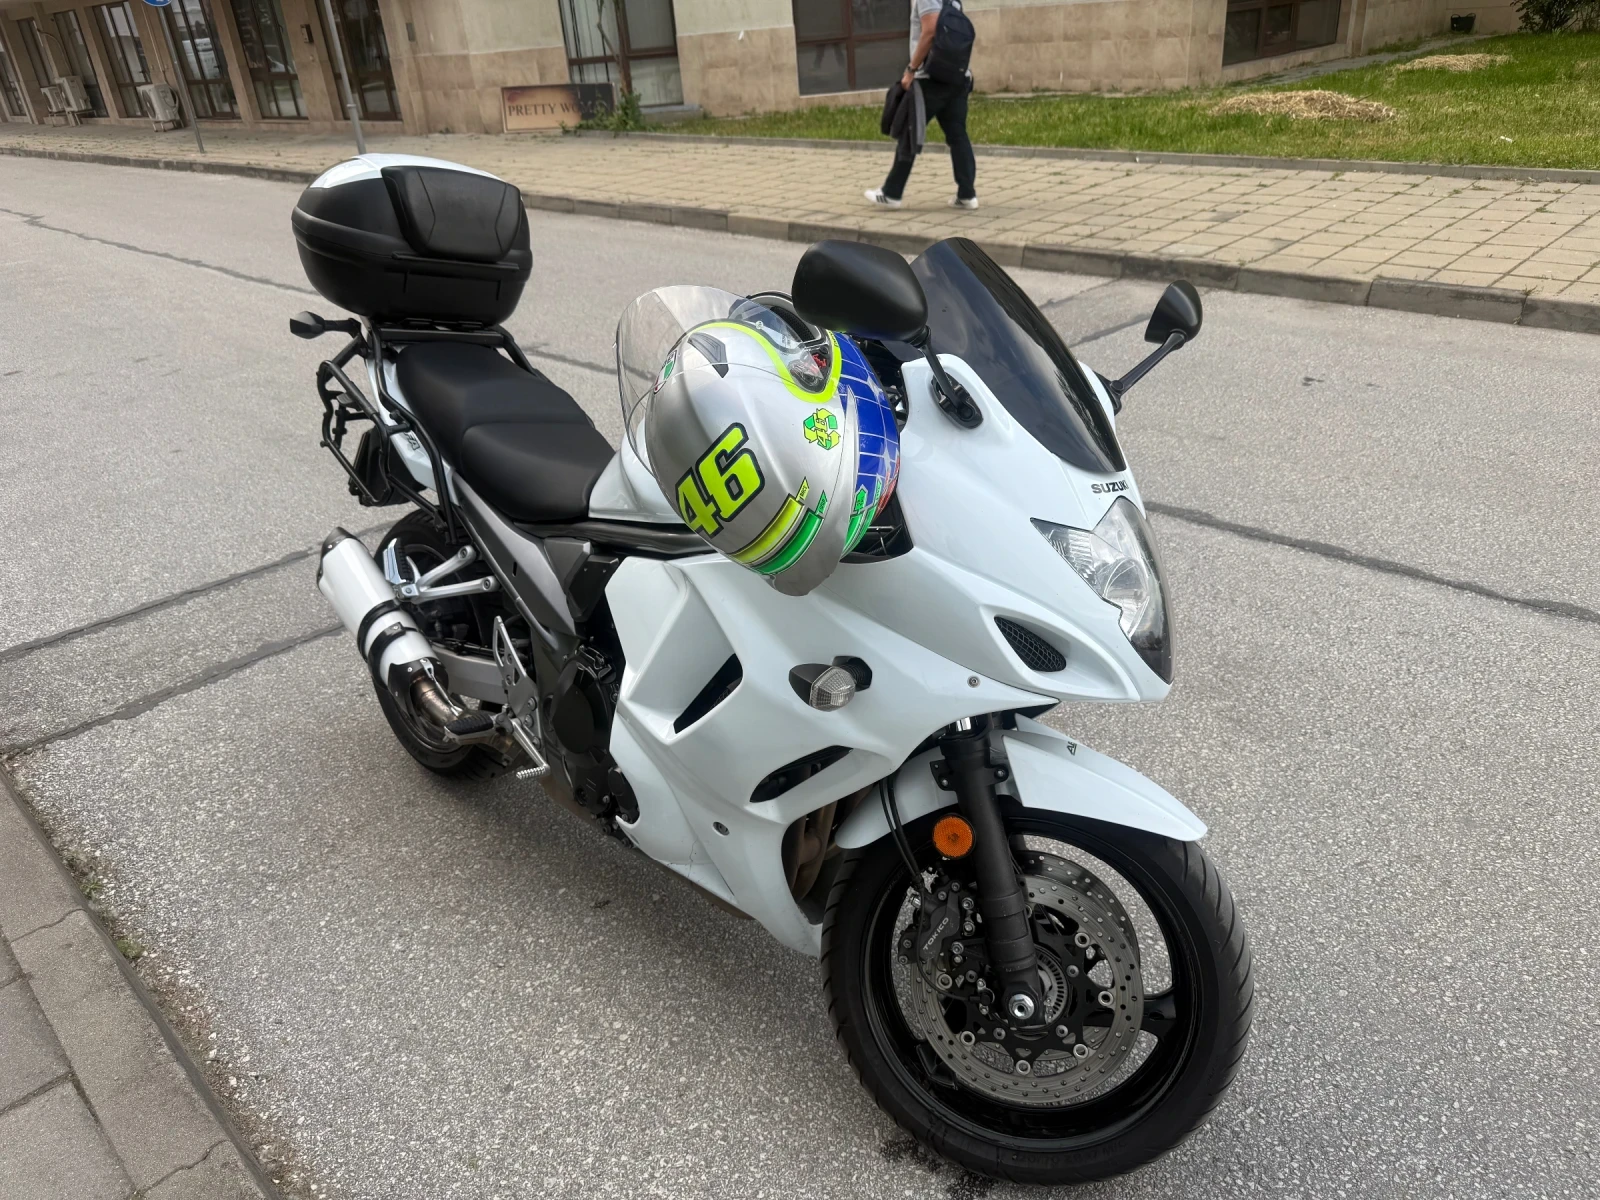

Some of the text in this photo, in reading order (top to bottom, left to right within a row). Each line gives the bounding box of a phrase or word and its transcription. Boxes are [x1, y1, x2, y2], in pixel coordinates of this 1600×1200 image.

[508, 103, 556, 116] PRETTY
[675, 422, 765, 539] 46
[1091, 480, 1129, 493] SUZUKI
[923, 917, 949, 950] TOKICO
